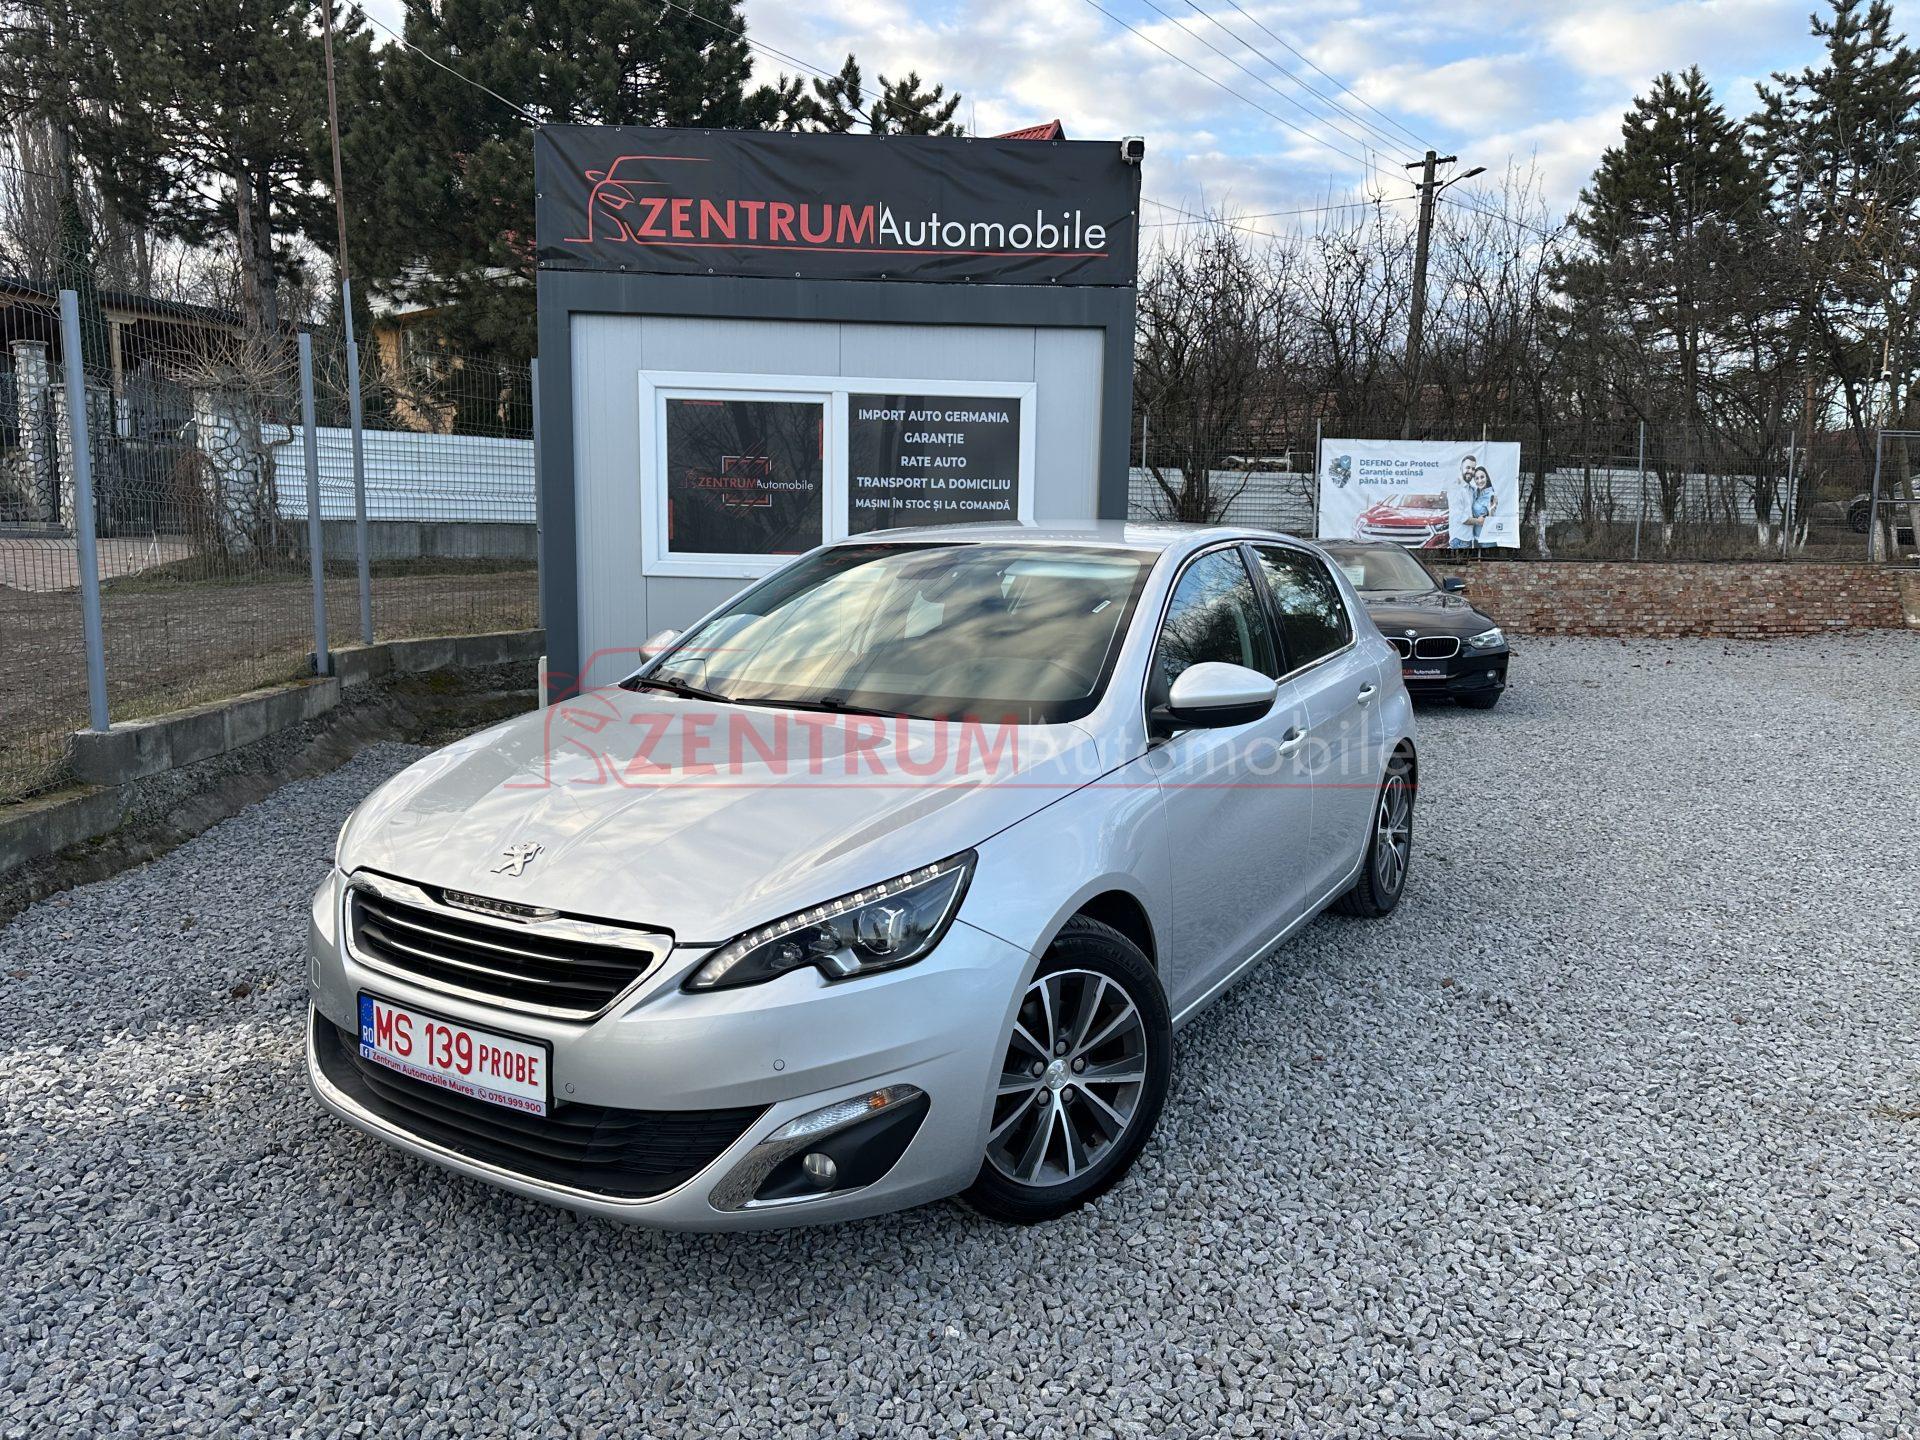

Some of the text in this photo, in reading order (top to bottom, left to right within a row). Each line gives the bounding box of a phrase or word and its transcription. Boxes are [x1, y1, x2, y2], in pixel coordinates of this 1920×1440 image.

[637, 197, 1107, 250] ZENTRUM Automobile
[858, 408, 1010, 423] IMPORT AUTO GERMANIA
[904, 432, 965, 447] GARANȚIE
[900, 456, 967, 468] RATE AUTO
[1359, 459, 1393, 467] DEFEND
[1409, 460, 1440, 468] Protect
[1359, 468, 1393, 477] Garanție
[698, 477, 814, 491] ZENTRUM Automobile
[856, 476, 1011, 490] TRANSPORT LA DOMICILIU
[1380, 477, 1388, 485] la
[1389, 477, 1395, 485] 3
[1396, 477, 1409, 485] ani
[855, 497, 1011, 511] MAȘINI ÎN STOC ȘI LA COMANDĂ
[361, 1025, 374, 1044] RO
[375, 1005, 539, 1086] MS 139 PROBE
[372, 1052, 401, 1070] Zentrum
[402, 1064, 448, 1087] Automobile
[449, 1079, 475, 1096] Mures
